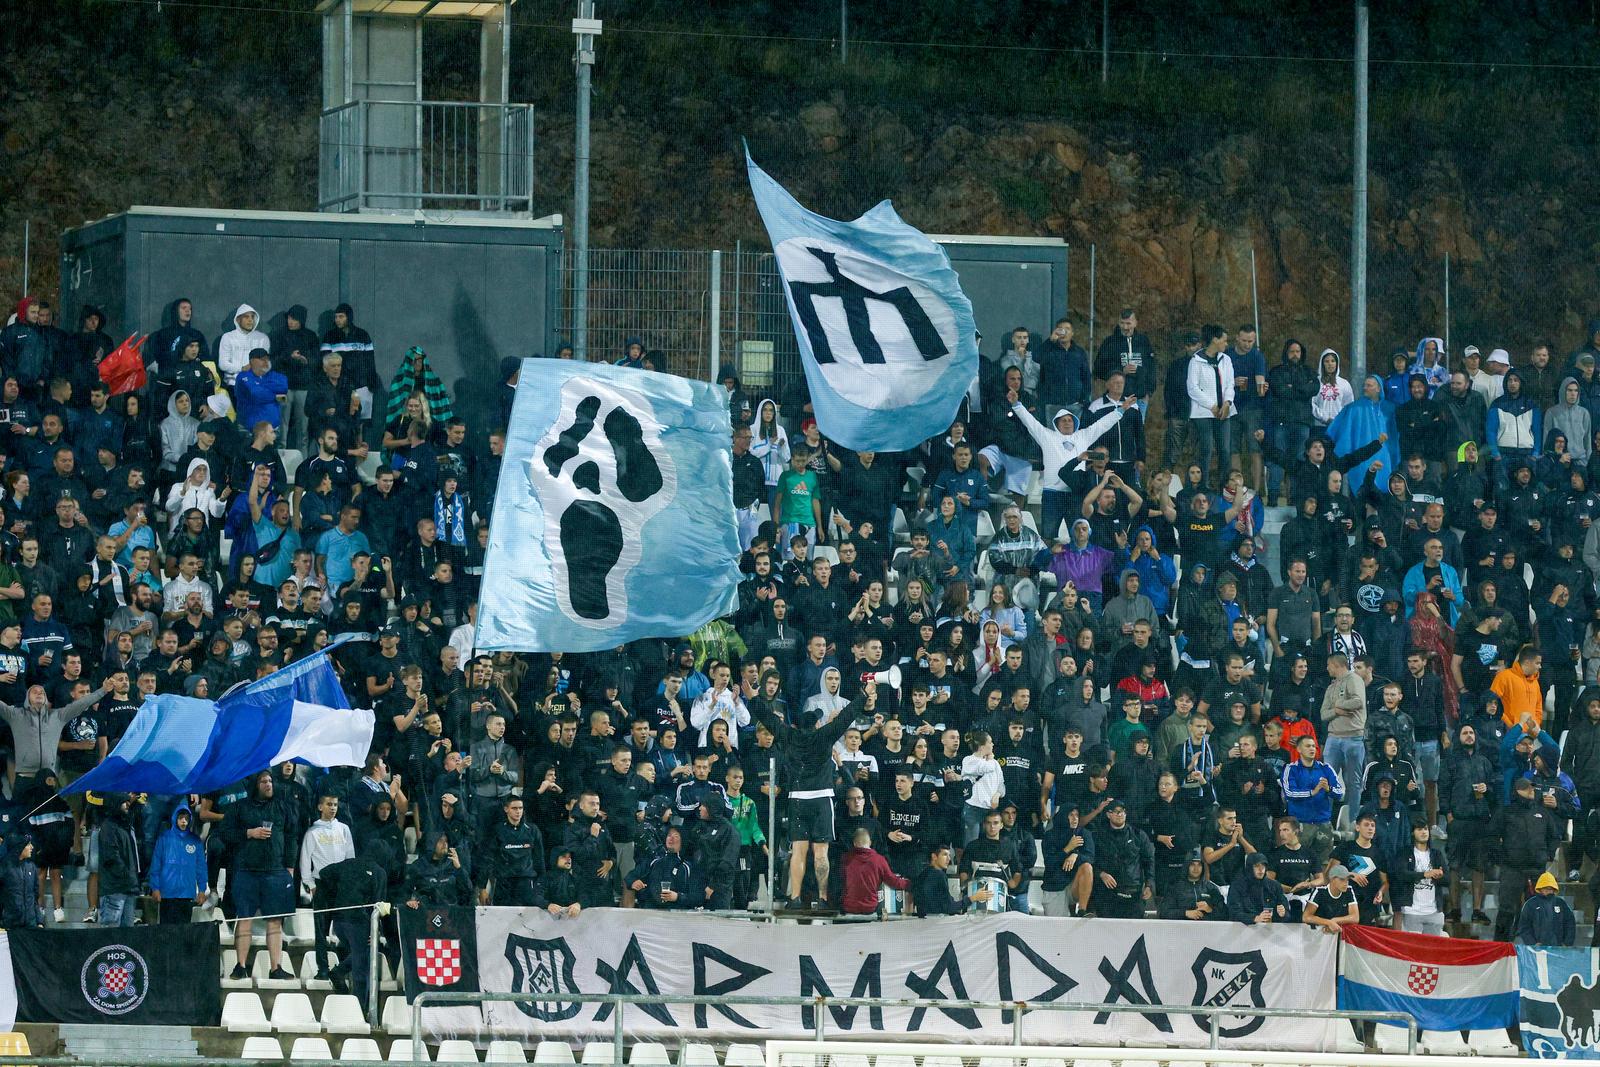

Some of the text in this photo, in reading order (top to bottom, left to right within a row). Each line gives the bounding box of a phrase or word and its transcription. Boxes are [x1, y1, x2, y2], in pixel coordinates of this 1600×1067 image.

[1063, 764, 1085, 775] NIKE
[1211, 967, 1226, 980] NK
[592, 930, 1174, 1034] ARMADA
[1206, 967, 1257, 1009] IJEKA
[93, 995, 101, 1004] ZA
